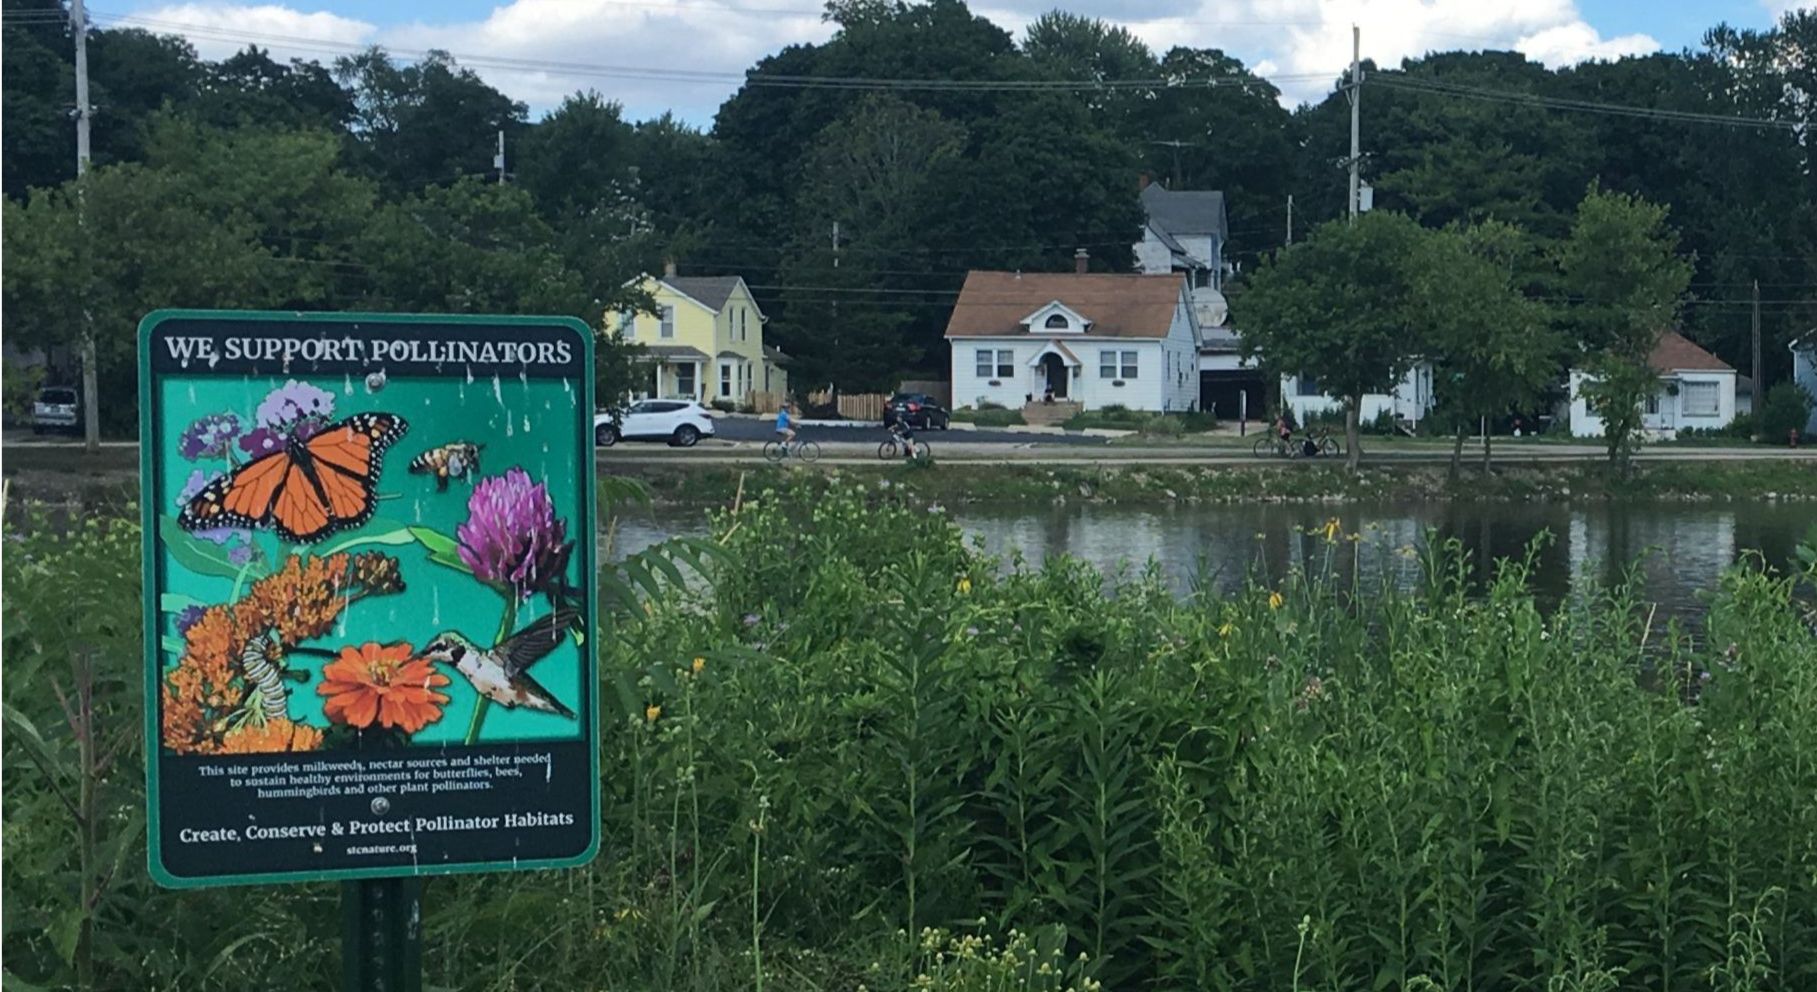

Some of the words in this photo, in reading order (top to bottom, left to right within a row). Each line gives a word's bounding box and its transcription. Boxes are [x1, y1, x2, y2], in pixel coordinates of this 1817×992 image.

[165, 336, 213, 359] WE
[225, 337, 362, 360] SUPPORT
[371, 340, 572, 364] POLLINATORS
[198, 766, 224, 776] This
[228, 764, 248, 775] site
[251, 762, 299, 776] provides
[302, 760, 366, 772] milkweeds,
[369, 759, 403, 770] nectar
[406, 758, 448, 769] sources
[450, 756, 470, 767] and
[473, 755, 510, 766] shelter
[513, 752, 551, 764] needed
[230, 778, 242, 787] to
[245, 776, 287, 787] sustain
[289, 774, 332, 786] healthy
[334, 770, 411, 783] environments
[414, 769, 430, 780] for
[433, 768, 493, 779] butterflies,
[495, 766, 523, 778] bees,
[257, 785, 341, 798] hummingbirds
[344, 785, 364, 795] and
[367, 783, 397, 794] other
[400, 781, 428, 794] plant
[432, 780, 493, 794] pollinators.
[179, 827, 241, 843] Create,
[245, 824, 326, 840] Conserve
[331, 821, 344, 836] &
[348, 819, 410, 834] Protect
[415, 816, 499, 832] Pollinator
[504, 811, 574, 828] Habitats
[346, 844, 417, 855] stcnature.org
